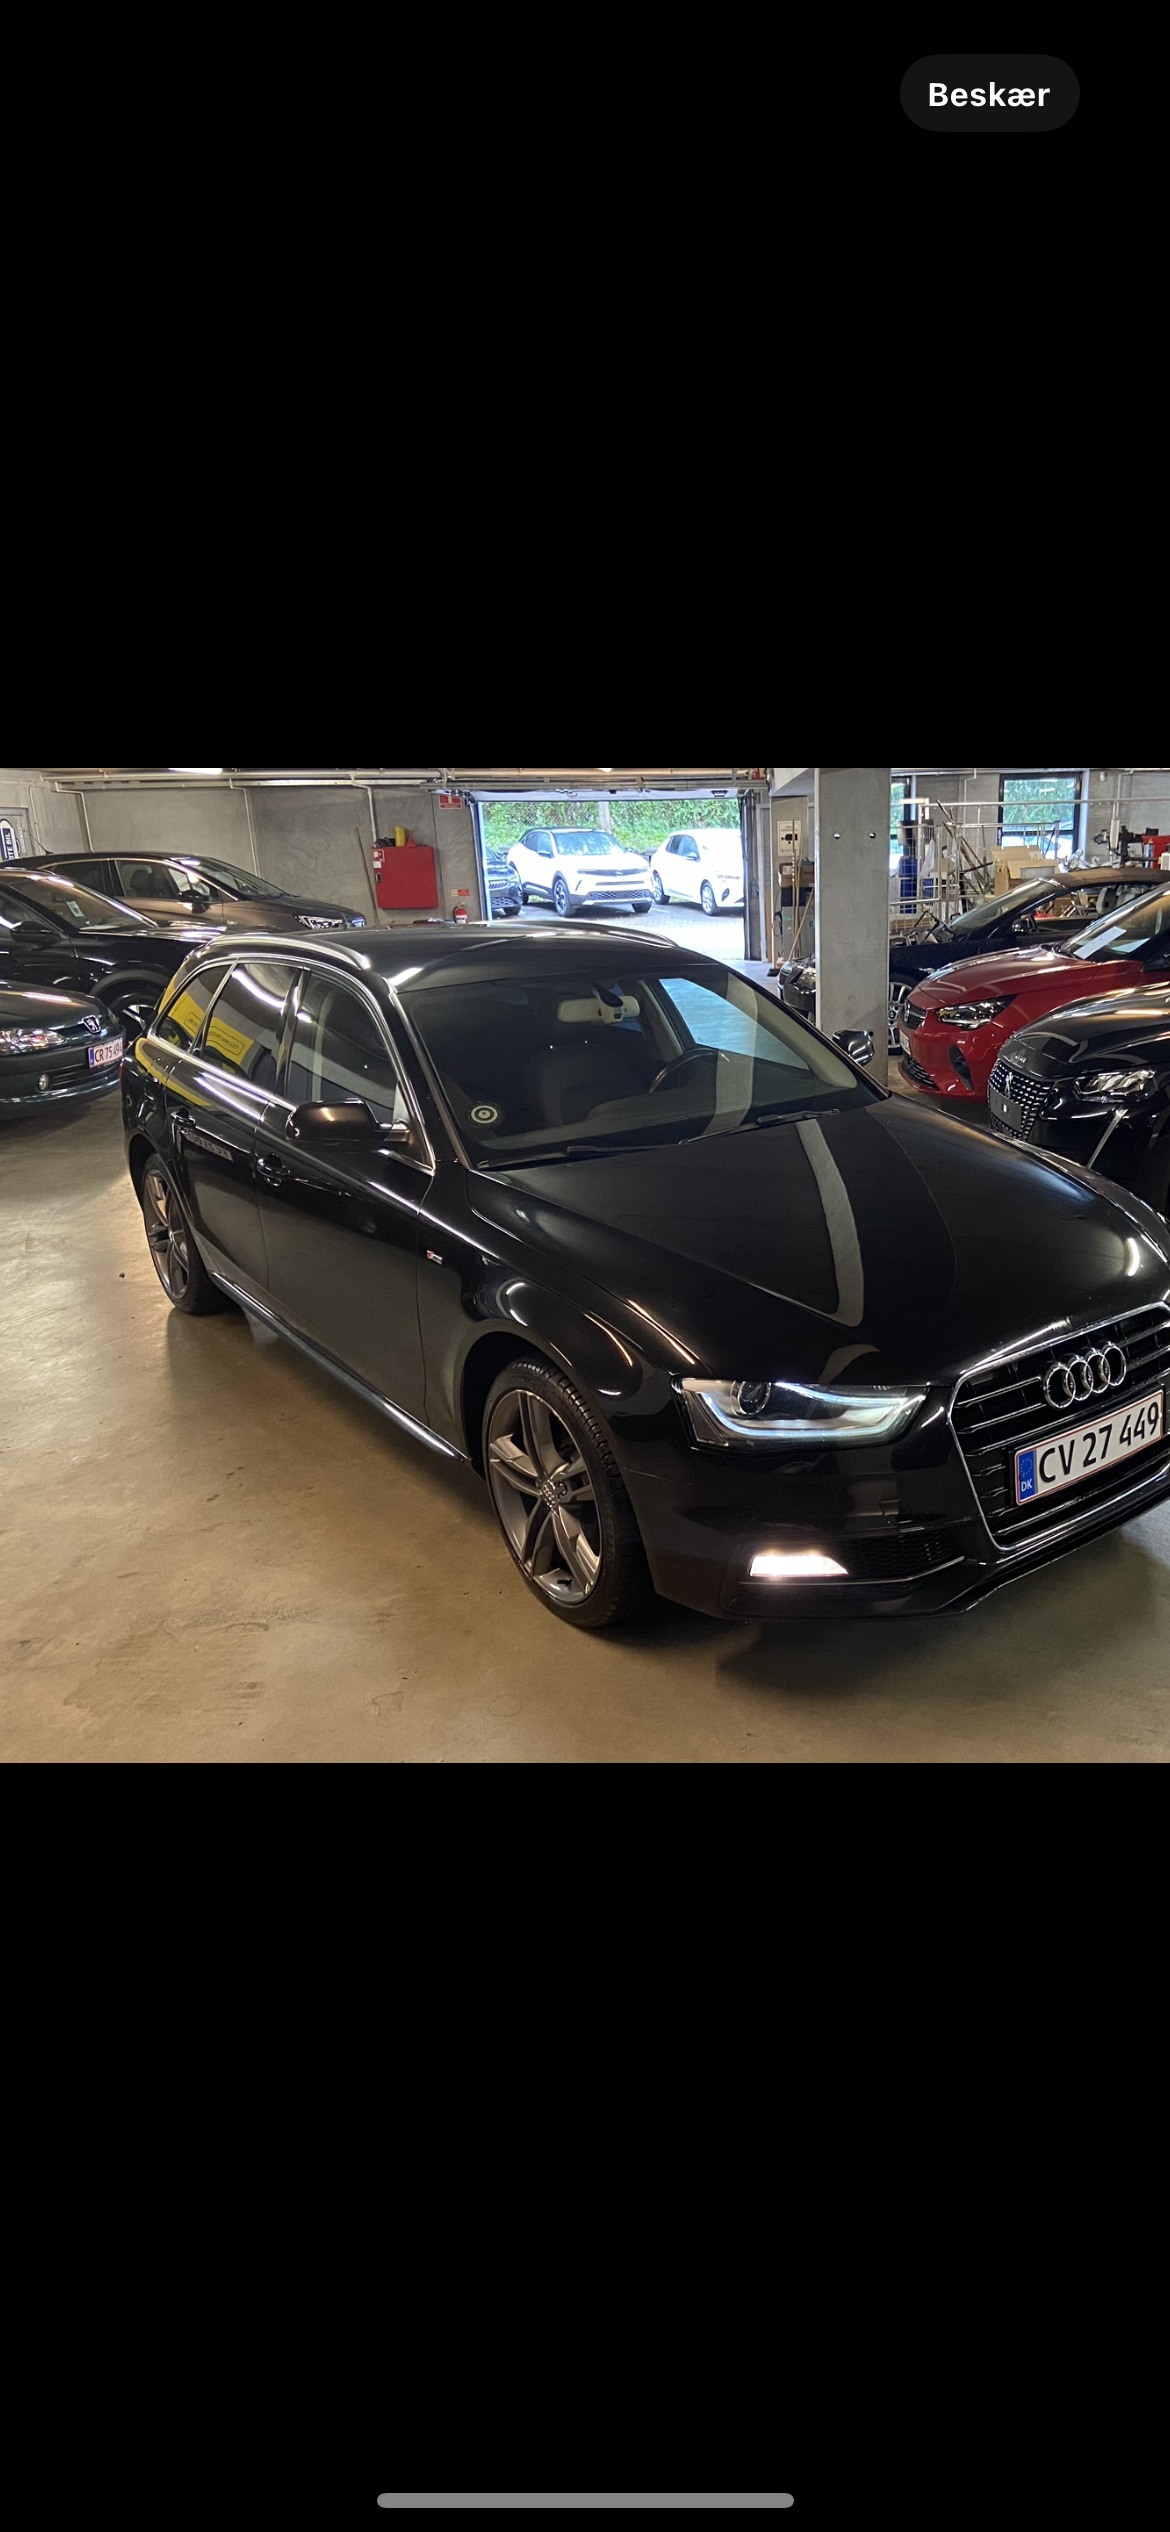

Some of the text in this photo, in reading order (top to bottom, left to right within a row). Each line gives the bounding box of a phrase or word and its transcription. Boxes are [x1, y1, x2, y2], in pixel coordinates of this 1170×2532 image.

[94, 1048, 104, 1062] CR
[105, 1046, 112, 1059] 75
[1039, 1401, 1159, 1483] CV 27 449
[1021, 1478, 1033, 1492] DK
